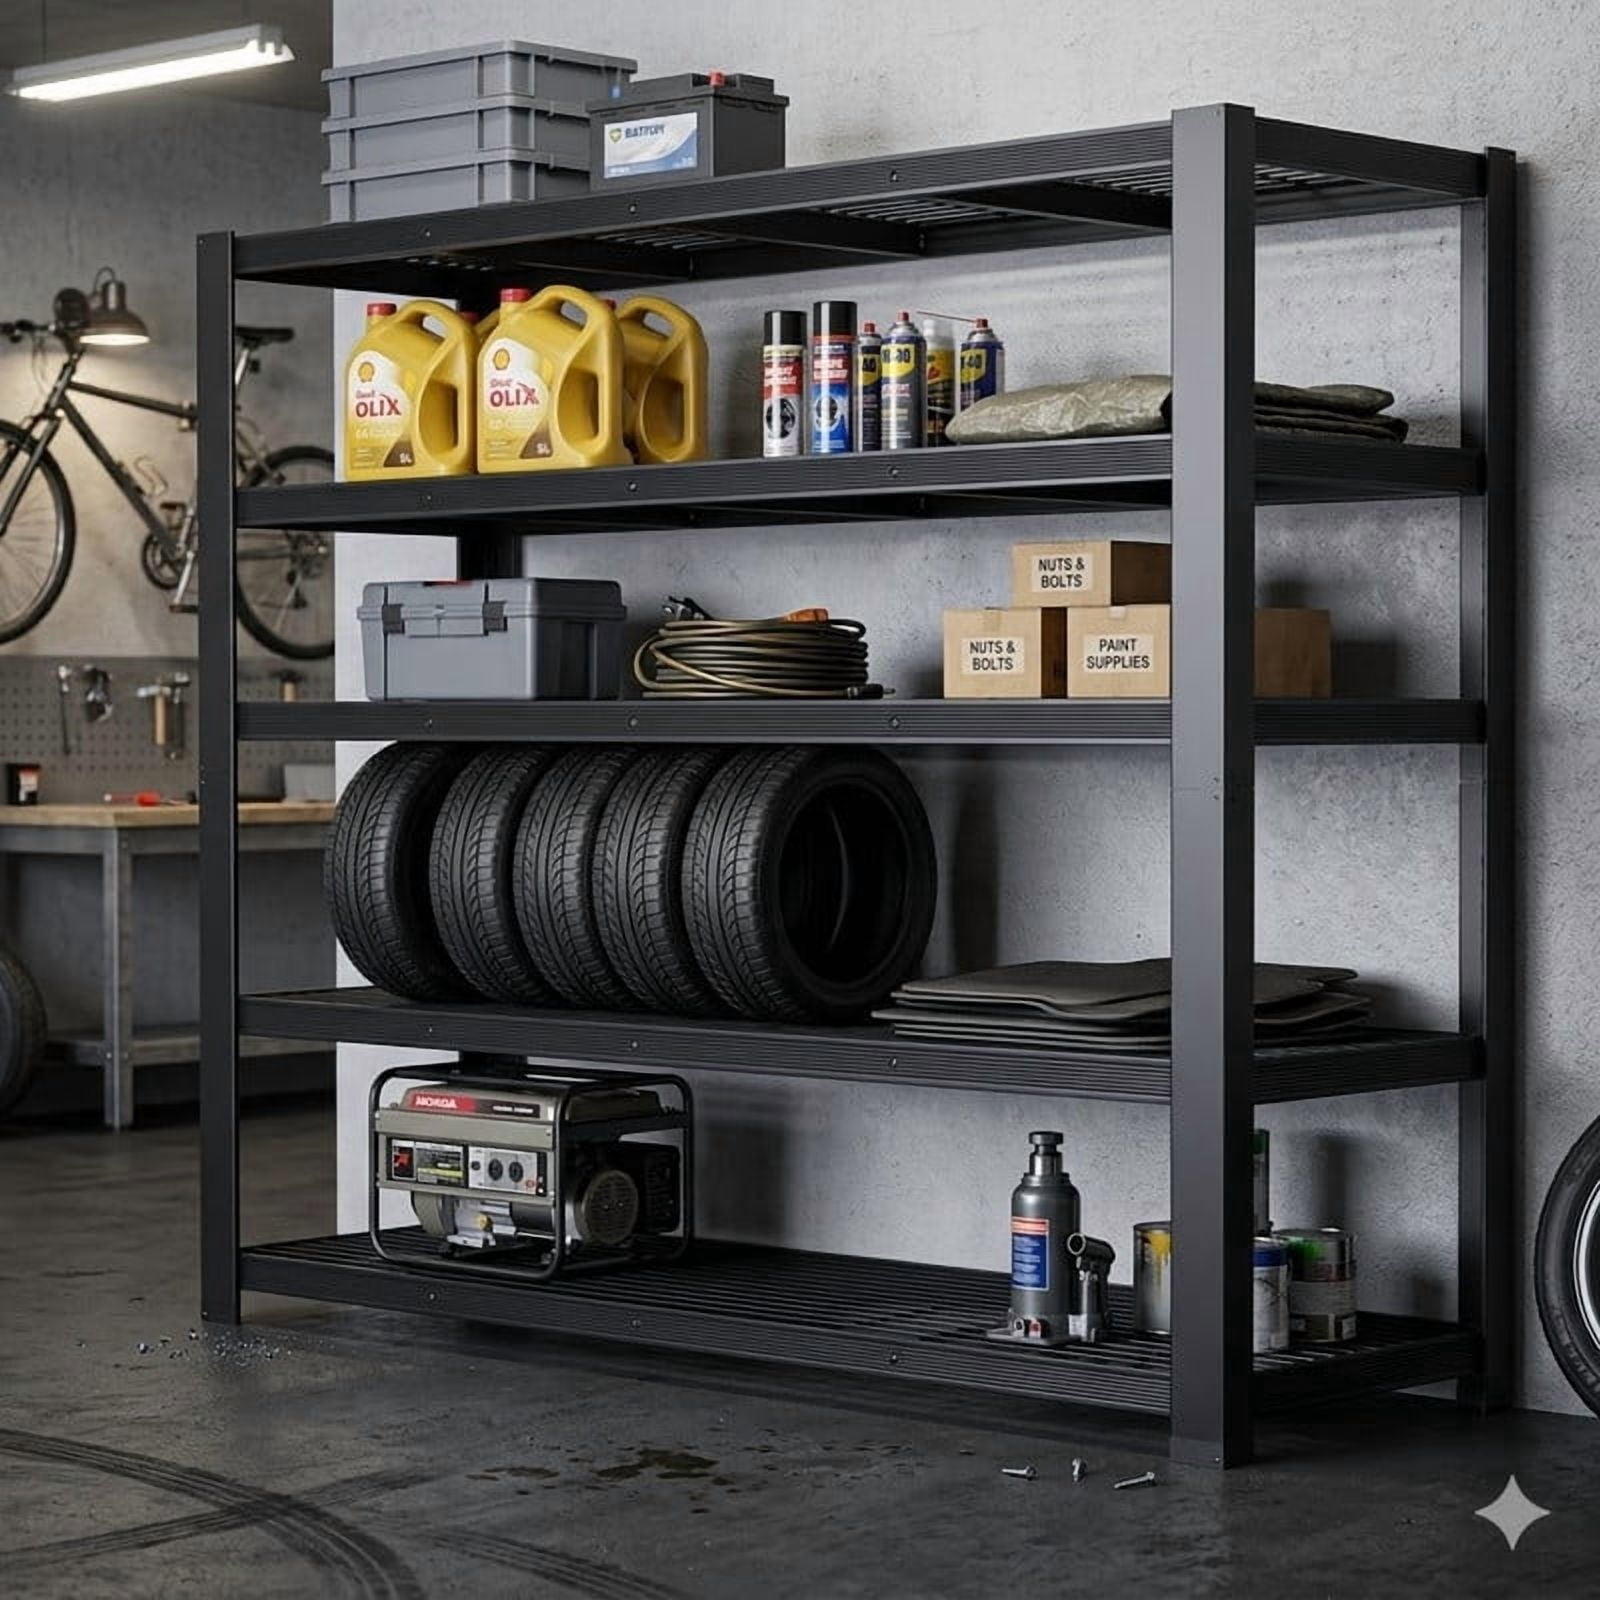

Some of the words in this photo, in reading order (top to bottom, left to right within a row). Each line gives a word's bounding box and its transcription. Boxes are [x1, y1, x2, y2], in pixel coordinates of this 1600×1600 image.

[490, 382, 540, 407] OLIX
[355, 393, 402, 417] OLIX
[1038, 557, 1073, 571] NUTS
[1075, 557, 1086, 570] &
[1041, 574, 1083, 588] BOLTS
[969, 640, 1004, 654] NUTS
[1006, 640, 1016, 654] &
[1099, 638, 1137, 652] PAINT
[972, 657, 1014, 671] BOLTS
[1086, 655, 1151, 670] SUPPLIES
